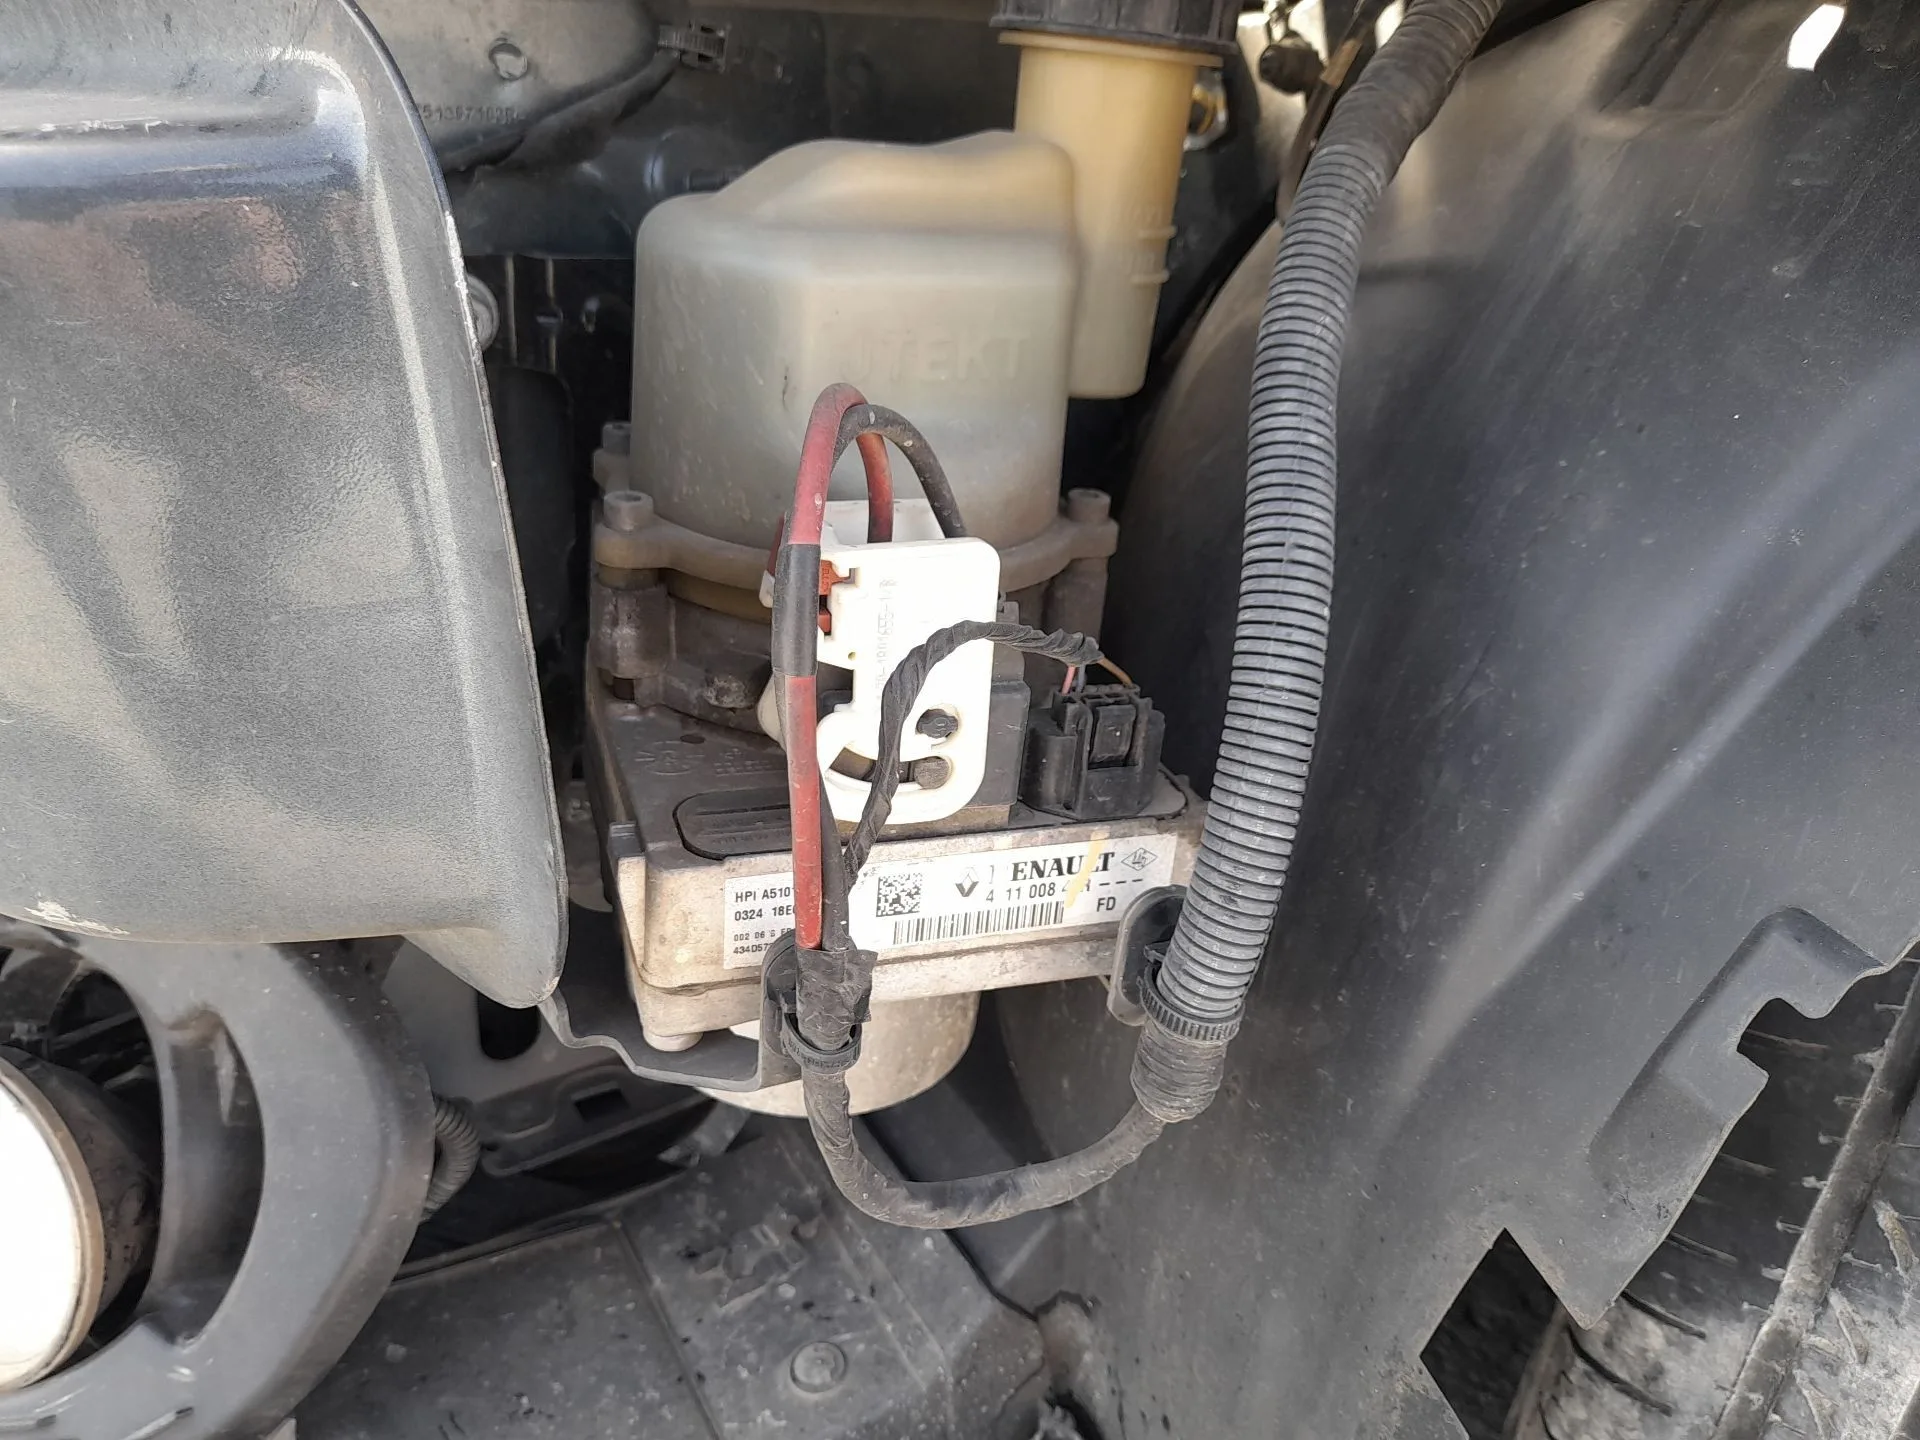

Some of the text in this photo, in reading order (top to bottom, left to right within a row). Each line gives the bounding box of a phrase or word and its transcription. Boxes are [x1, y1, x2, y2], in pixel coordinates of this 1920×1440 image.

[840, 327, 1031, 382] JTEKT
[735, 888, 756, 903] HPI
[1029, 882, 1055, 899] 008
[1096, 896, 1117, 912] FD
[734, 908, 763, 921] 0324
